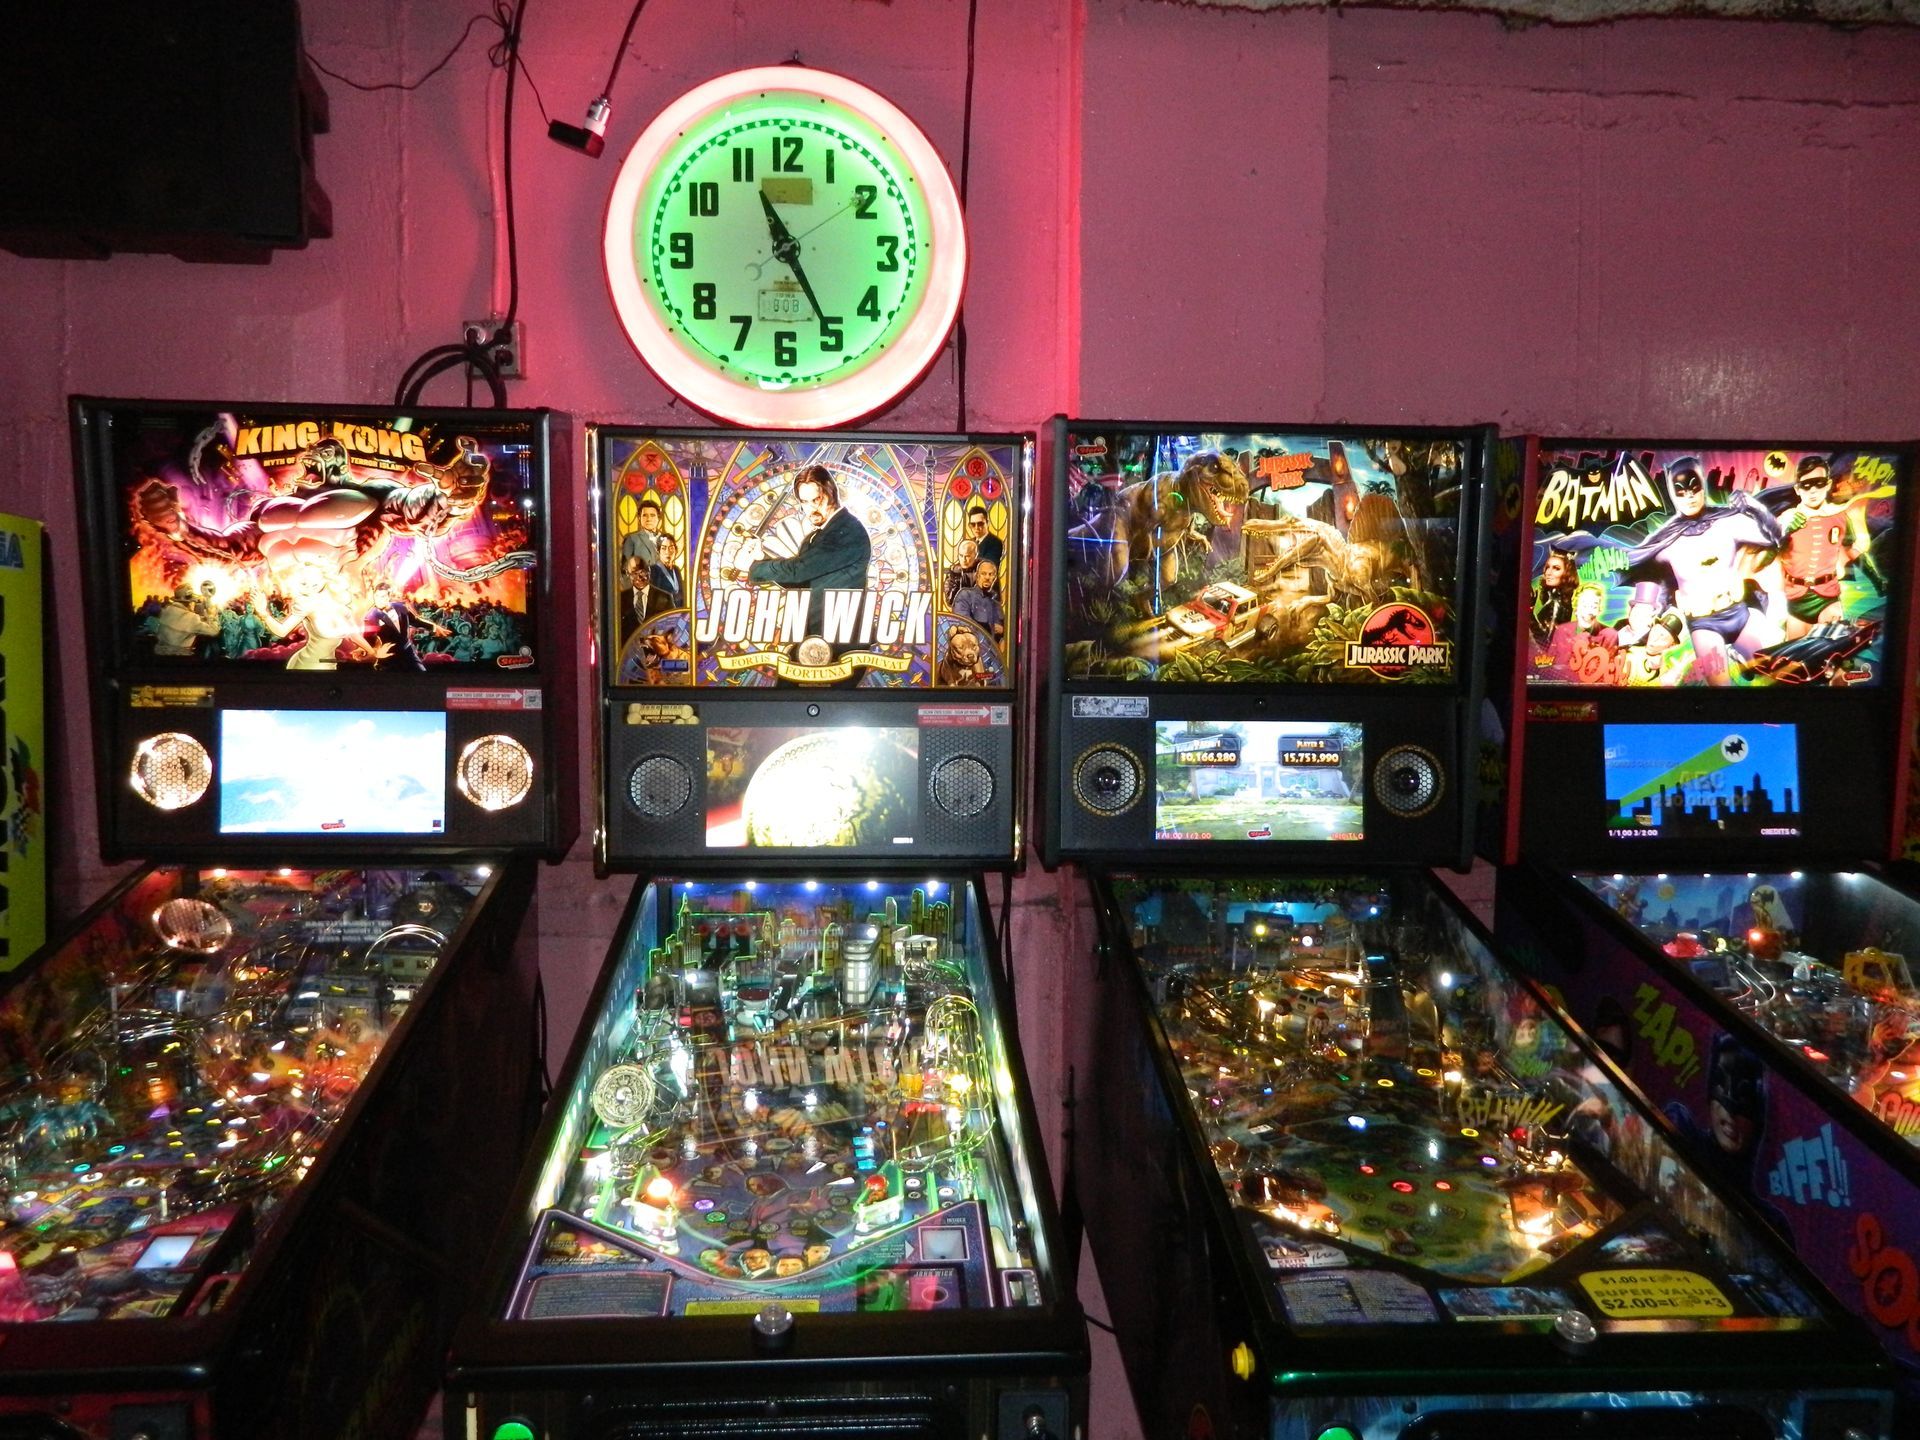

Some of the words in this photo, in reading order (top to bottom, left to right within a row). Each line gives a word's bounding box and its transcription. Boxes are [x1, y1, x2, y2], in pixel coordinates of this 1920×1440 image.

[732, 147, 754, 182] 11
[772, 137, 804, 173] 12
[825, 149, 835, 184] 1
[688, 182, 719, 217] 10
[854, 184, 878, 220] 2
[669, 232, 694, 270] 9
[876, 235, 899, 272] 3
[692, 282, 717, 320] 8
[856, 285, 881, 322] 4
[729, 315, 753, 351] 7
[774, 331, 797, 367] 6
[819, 316, 844, 352] 5
[236, 421, 320, 456] KING
[333, 421, 427, 462] KONG
[263, 458, 285, 467] MYTH
[286, 457, 297, 465] OF
[350, 457, 378, 468] TERROR
[379, 461, 406, 472] ISLAND
[1256, 452, 1315, 478] JURASSIC
[1271, 470, 1305, 491] PARK
[1534, 459, 1663, 530] BATMAN
[695, 588, 812, 644] JOHN
[822, 588, 934, 645] WICK
[730, 653, 771, 666] FORTIS
[785, 665, 846, 680] FORTUNA
[855, 655, 904, 671] ADIUVAT
[1348, 644, 1407, 666] JURASSIC
[1407, 644, 1445, 666] PARK
[1296, 740, 1318, 749] PLAYER
[1319, 740, 1325, 748] 2
[1594, 1288, 1653, 1298] SUPER
[1659, 1288, 1715, 1297] VALUE
